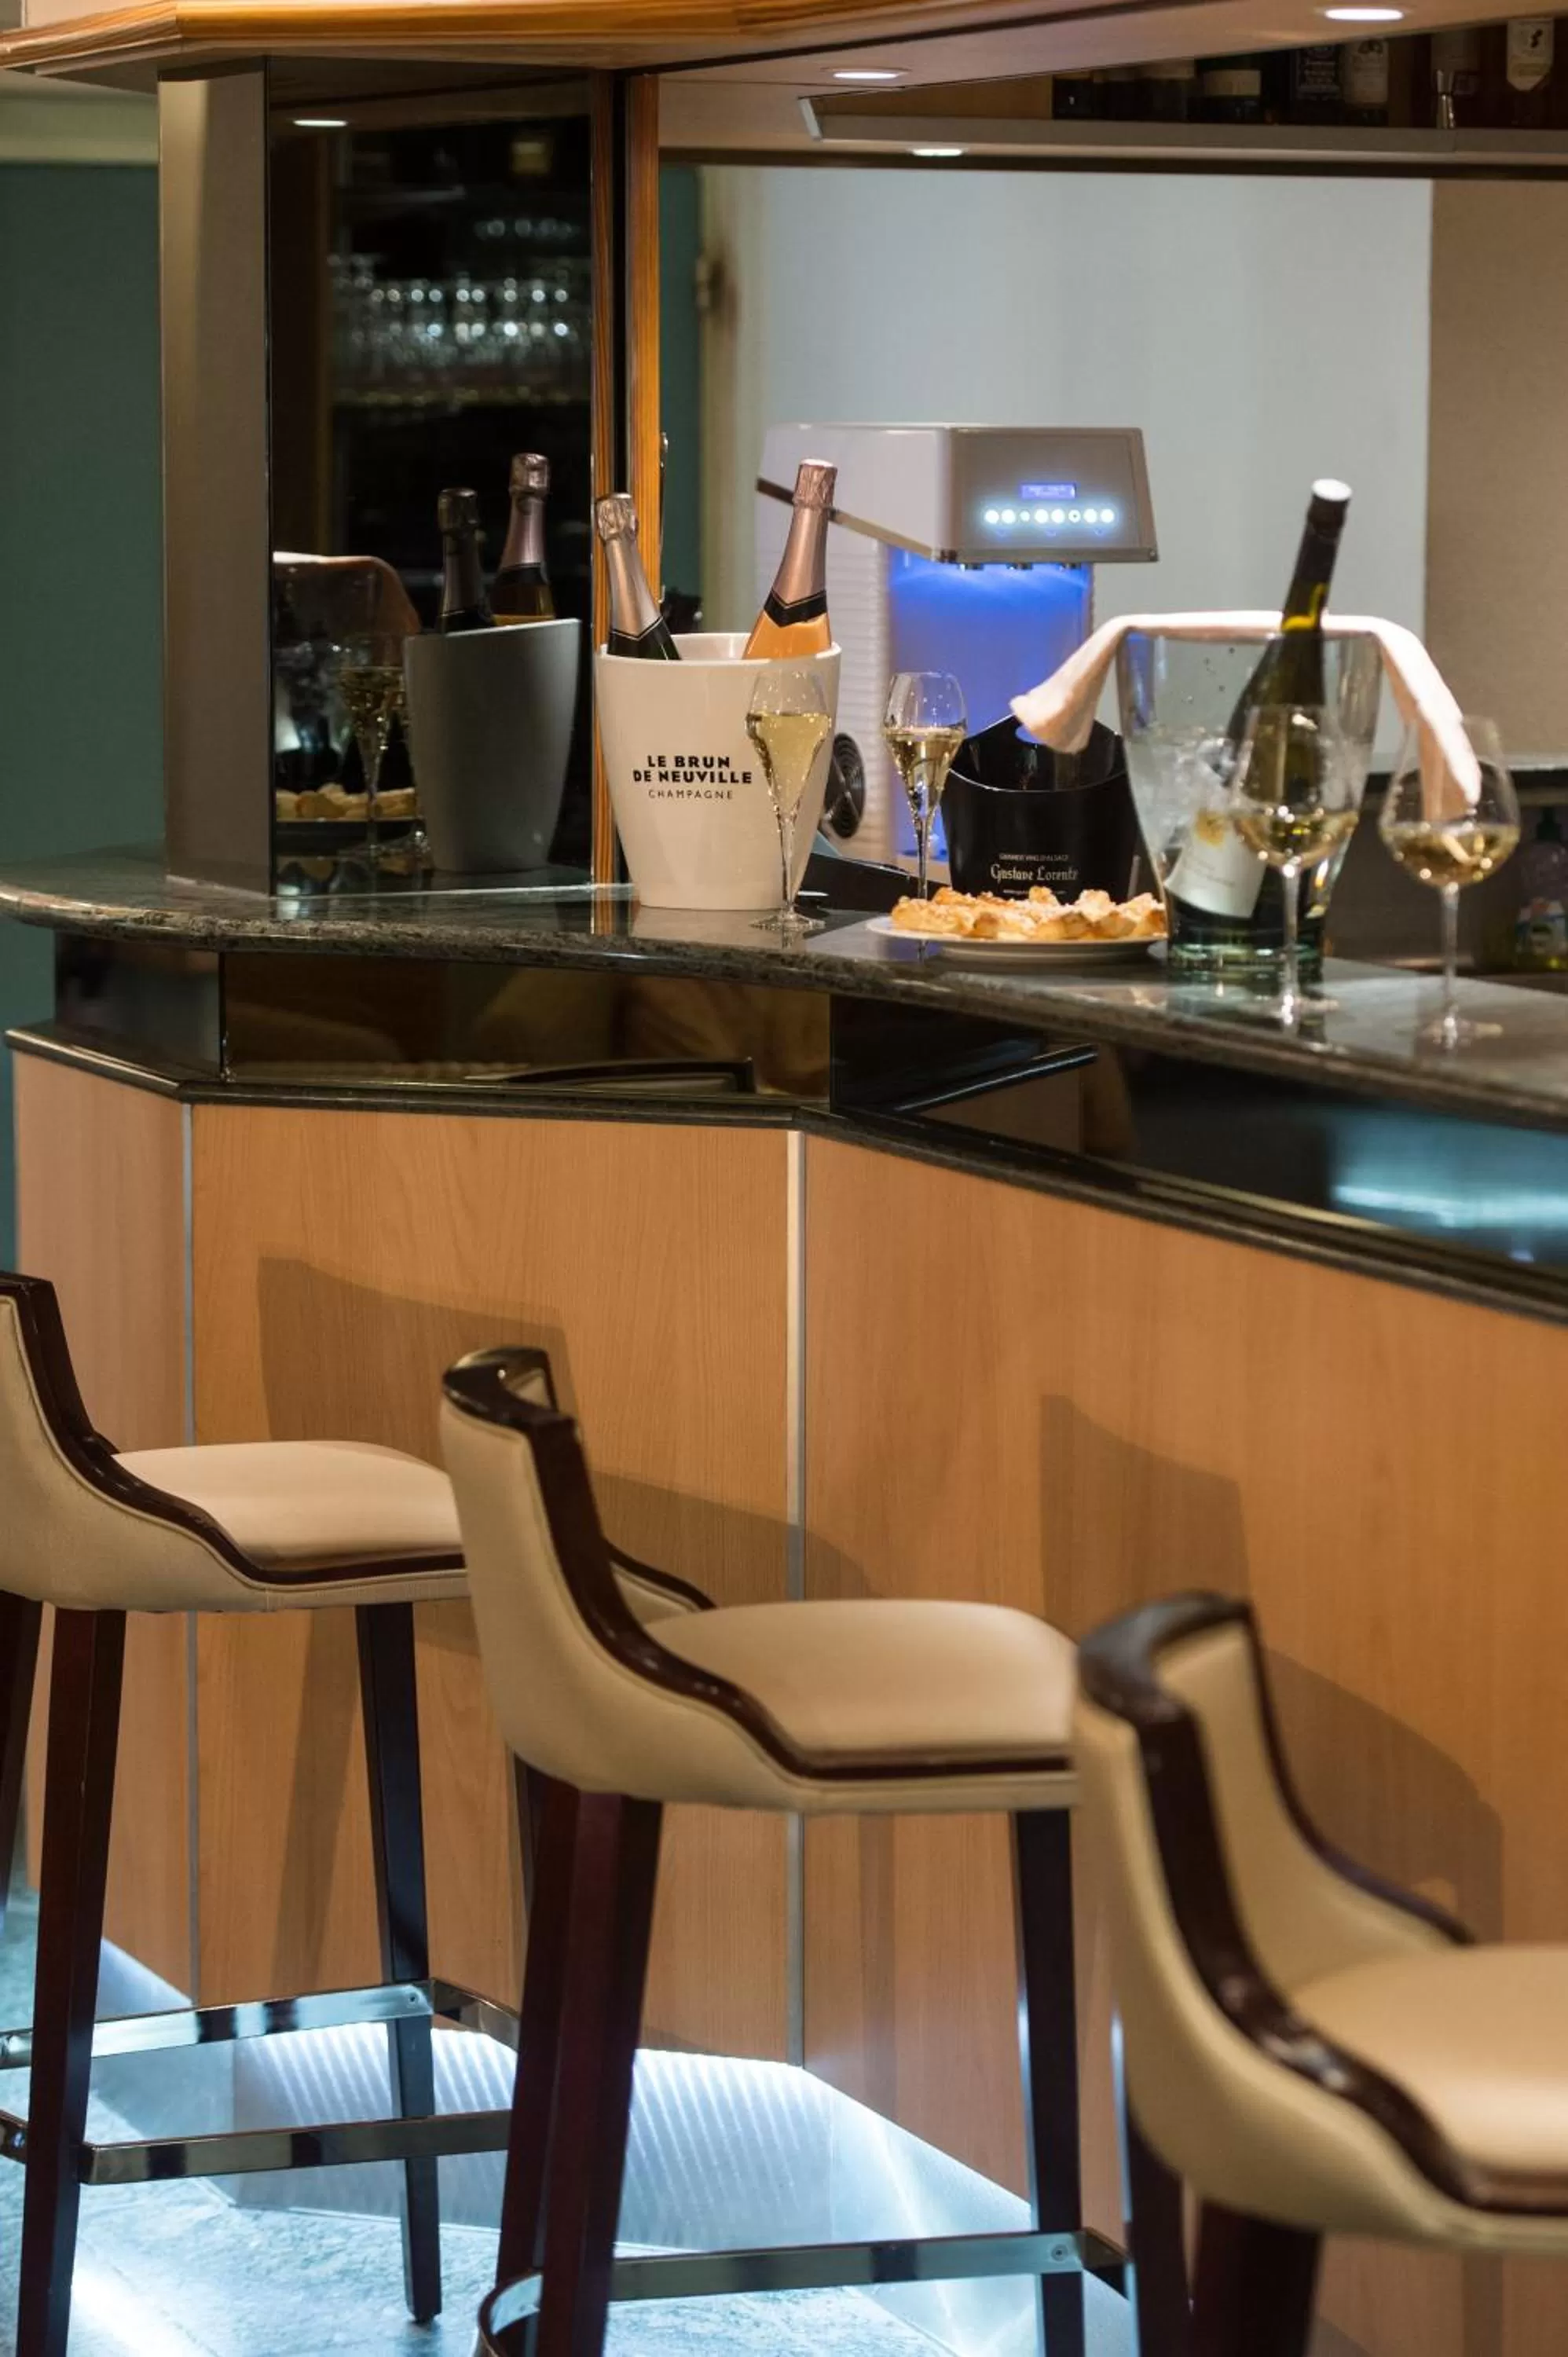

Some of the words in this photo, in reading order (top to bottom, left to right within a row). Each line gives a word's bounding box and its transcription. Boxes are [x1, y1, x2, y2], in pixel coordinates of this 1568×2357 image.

[647, 755, 667, 768] LE
[674, 756, 731, 768] BRUN
[633, 770, 651, 783] DE
[658, 771, 753, 784] NEUVILLE
[648, 789, 734, 800] CHAMPAGNE
[990, 863, 1034, 883] Gustave
